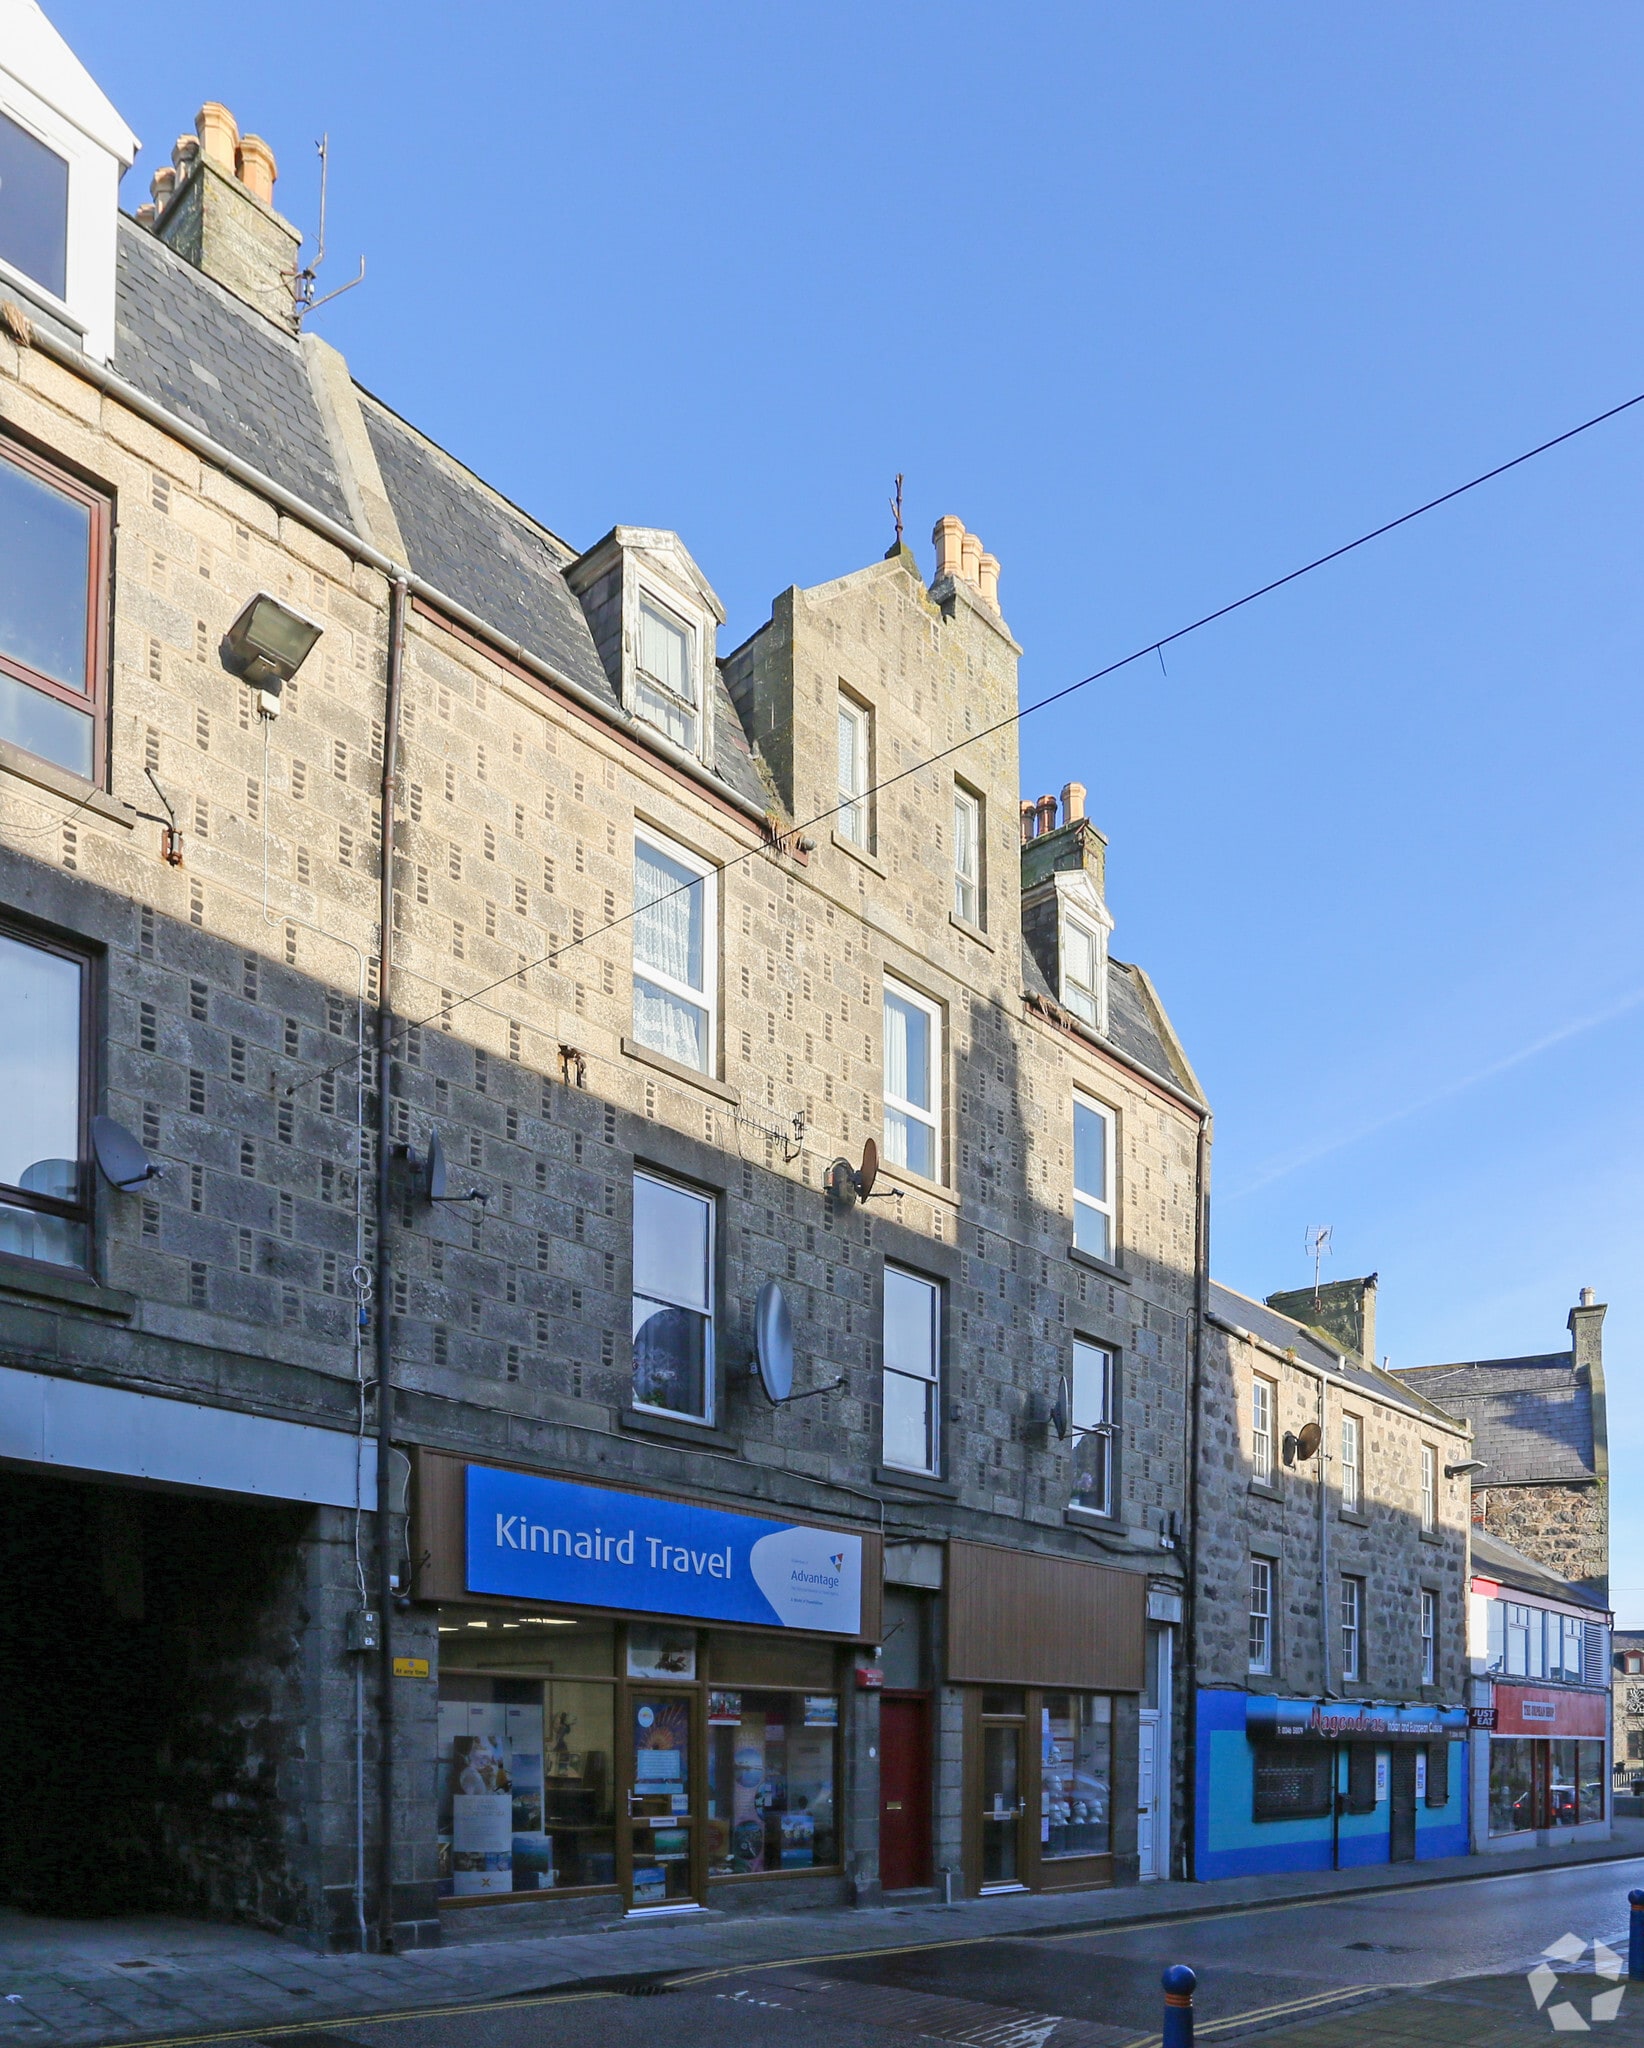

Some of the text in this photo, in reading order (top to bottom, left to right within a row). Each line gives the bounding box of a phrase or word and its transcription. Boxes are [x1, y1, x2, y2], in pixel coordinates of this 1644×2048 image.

[495, 1512, 732, 1580] Kinnaird Travel
[790, 1569, 839, 1589] Advantage
[1311, 1705, 1386, 1738] Nagendras
[1472, 1709, 1495, 1718] JUST
[1477, 1717, 1494, 1726] EAT
